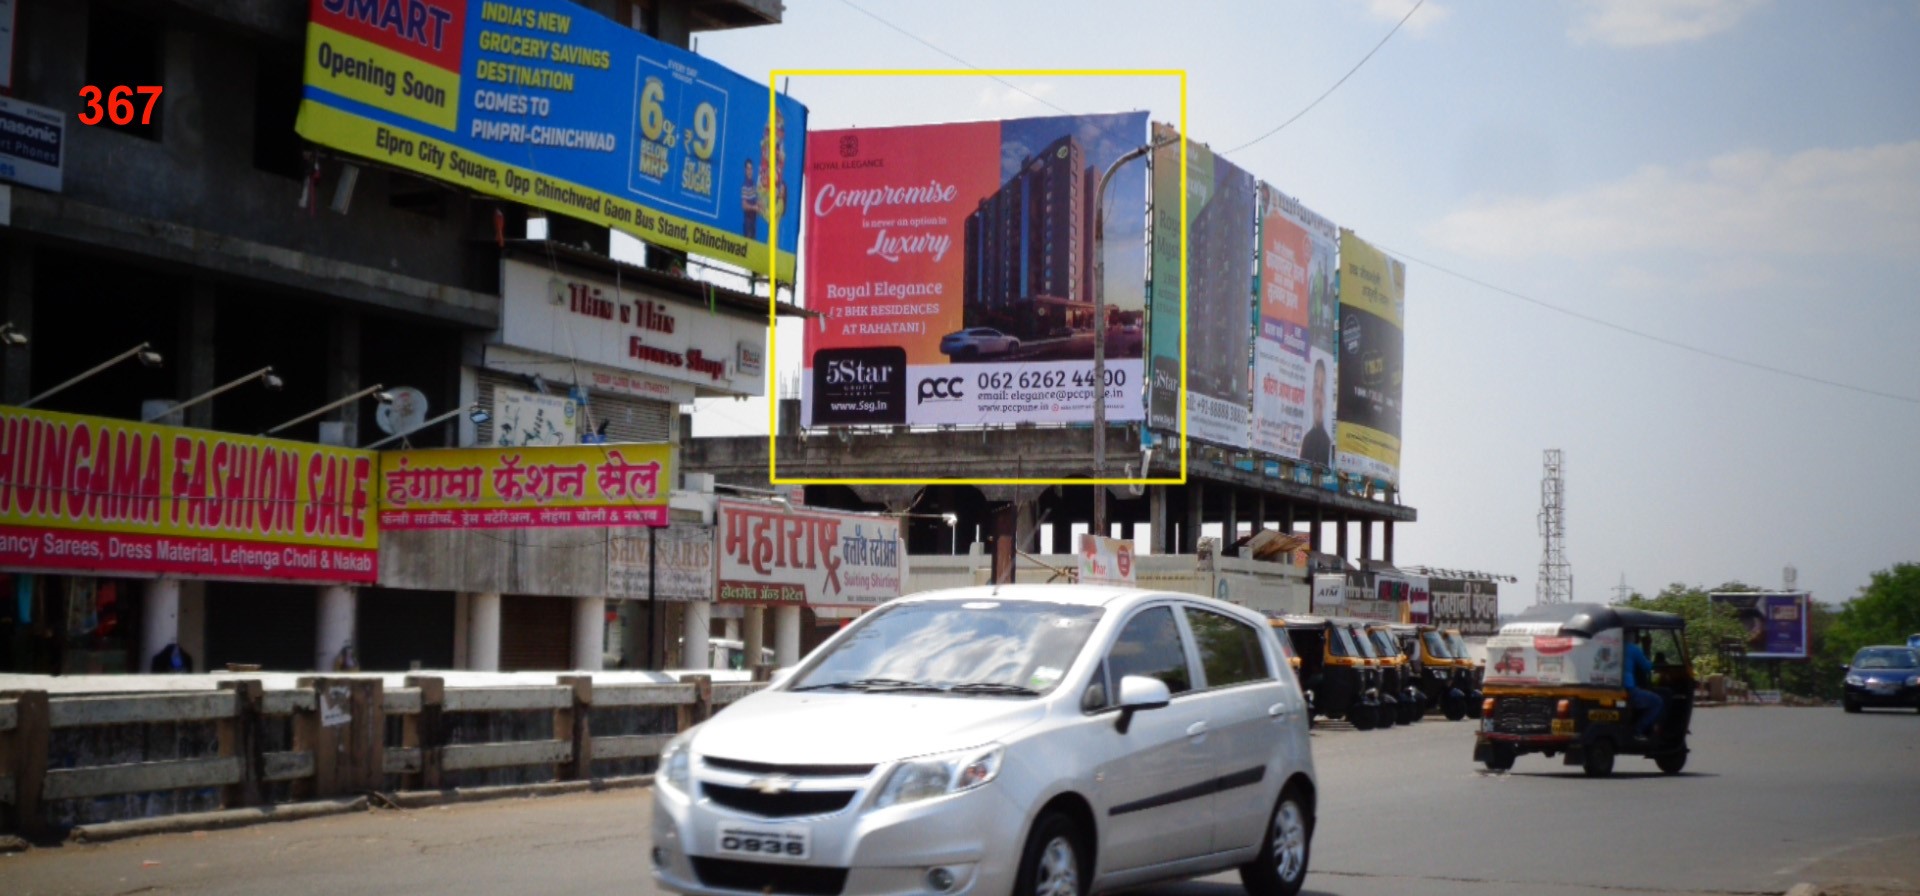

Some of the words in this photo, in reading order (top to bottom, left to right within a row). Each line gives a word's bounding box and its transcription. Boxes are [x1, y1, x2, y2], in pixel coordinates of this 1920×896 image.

[322, 0, 452, 51] MART
[481, 1, 536, 28] INDIA'S
[538, 11, 571, 34] NEW
[480, 30, 549, 59] GROCERY
[551, 42, 610, 69] SAVINGS
[318, 42, 396, 96] Opening
[403, 70, 446, 108] Soon
[476, 60, 574, 91] DESTINATION
[474, 90, 528, 115] COMES
[530, 97, 549, 116] TO
[471, 119, 615, 152] PIMPRI-CHINCHWAD
[640, 153, 669, 179] MRP
[813, 161, 840, 171] ROYAL
[841, 159, 884, 170] ELEGANCE
[376, 127, 413, 156] Elpro
[419, 141, 445, 170] City
[450, 151, 499, 189] Square,
[505, 169, 530, 196] Opp
[535, 177, 600, 213] Chinchwad
[604, 197, 632, 223] Gaon
[635, 206, 654, 231] Bus
[658, 216, 689, 245] Stand,
[693, 227, 748, 258] Chinchwad
[682, 170, 711, 196] SUGAR
[814, 179, 957, 217] Compromise
[862, 219, 870, 228] is
[871, 218, 895, 228] never
[897, 218, 908, 227] an
[910, 216, 937, 228] option
[938, 216, 947, 225] in
[867, 229, 952, 262] Luxury
[827, 282, 870, 300] Royal
[874, 282, 942, 299] Elegance
[568, 282, 614, 321] Thin
[634, 300, 675, 334] Thin
[836, 308, 843, 318] 2
[845, 306, 869, 318] BHK
[870, 303, 940, 317] RESIDENCES
[842, 324, 857, 335] AT
[859, 322, 920, 335] RAHATANI
[826, 359, 893, 384] 5Star
[978, 372, 1012, 390] 062
[1019, 371, 1065, 389] 6262
[917, 376, 964, 405] pcc
[977, 390, 1008, 401] email:
[1011, 389, 1123, 402] elegance@pccpue.in
[831, 400, 887, 412] www.5sg.in
[0, 413, 161, 528] HUNGAMA
[171, 434, 299, 537] FASHION
[303, 451, 371, 542] SALE
[385, 456, 484, 508] हंगामा
[492, 452, 587, 504] फॅशन
[596, 449, 661, 500] सेल
[577, 506, 606, 522] चोली
[610, 509, 620, 522] &
[0, 534, 38, 560] ancy
[44, 533, 103, 560] Sarees,
[109, 537, 152, 559] Dress
[157, 538, 217, 566] Material,
[222, 543, 279, 570] Lehenga
[283, 547, 317, 569] Choli
[321, 551, 330, 569] &
[333, 551, 372, 572] Nakab
[723, 507, 842, 596] महाराष्ट्र
[844, 572, 869, 591] Suiting
[871, 573, 898, 593] Shirting
[1317, 588, 1339, 598] ATM
